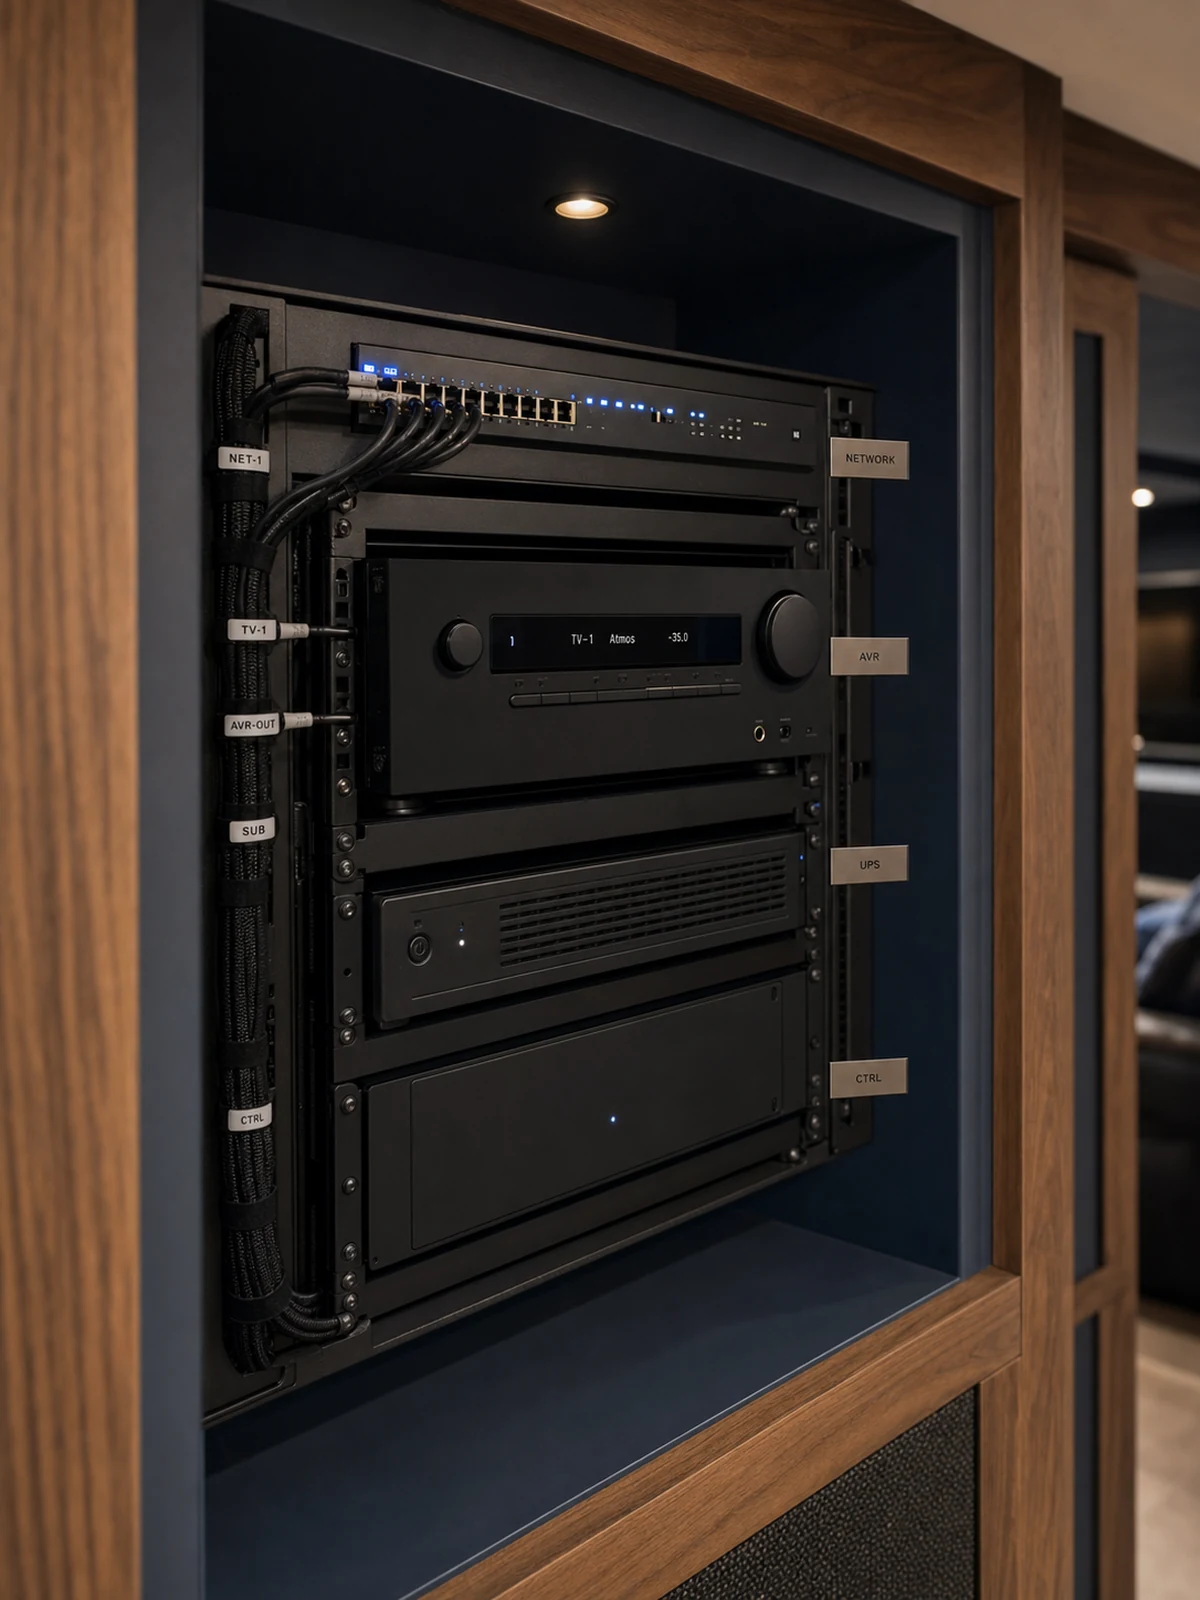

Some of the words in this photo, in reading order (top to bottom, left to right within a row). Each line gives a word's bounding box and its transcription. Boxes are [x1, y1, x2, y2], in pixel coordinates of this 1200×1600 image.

[229, 453, 262, 465] NET-1
[845, 453, 896, 465] NETWORK
[241, 624, 267, 635] TV-1
[571, 633, 594, 645] TV-1
[609, 633, 636, 644] Atmos
[668, 631, 689, 643] -35.0
[859, 652, 880, 662] AVR
[230, 719, 276, 730] AVR-OUT
[242, 824, 266, 836] SUB
[860, 860, 881, 870] UPS
[855, 1073, 882, 1084] CTRL
[240, 1112, 265, 1125] CTRL
